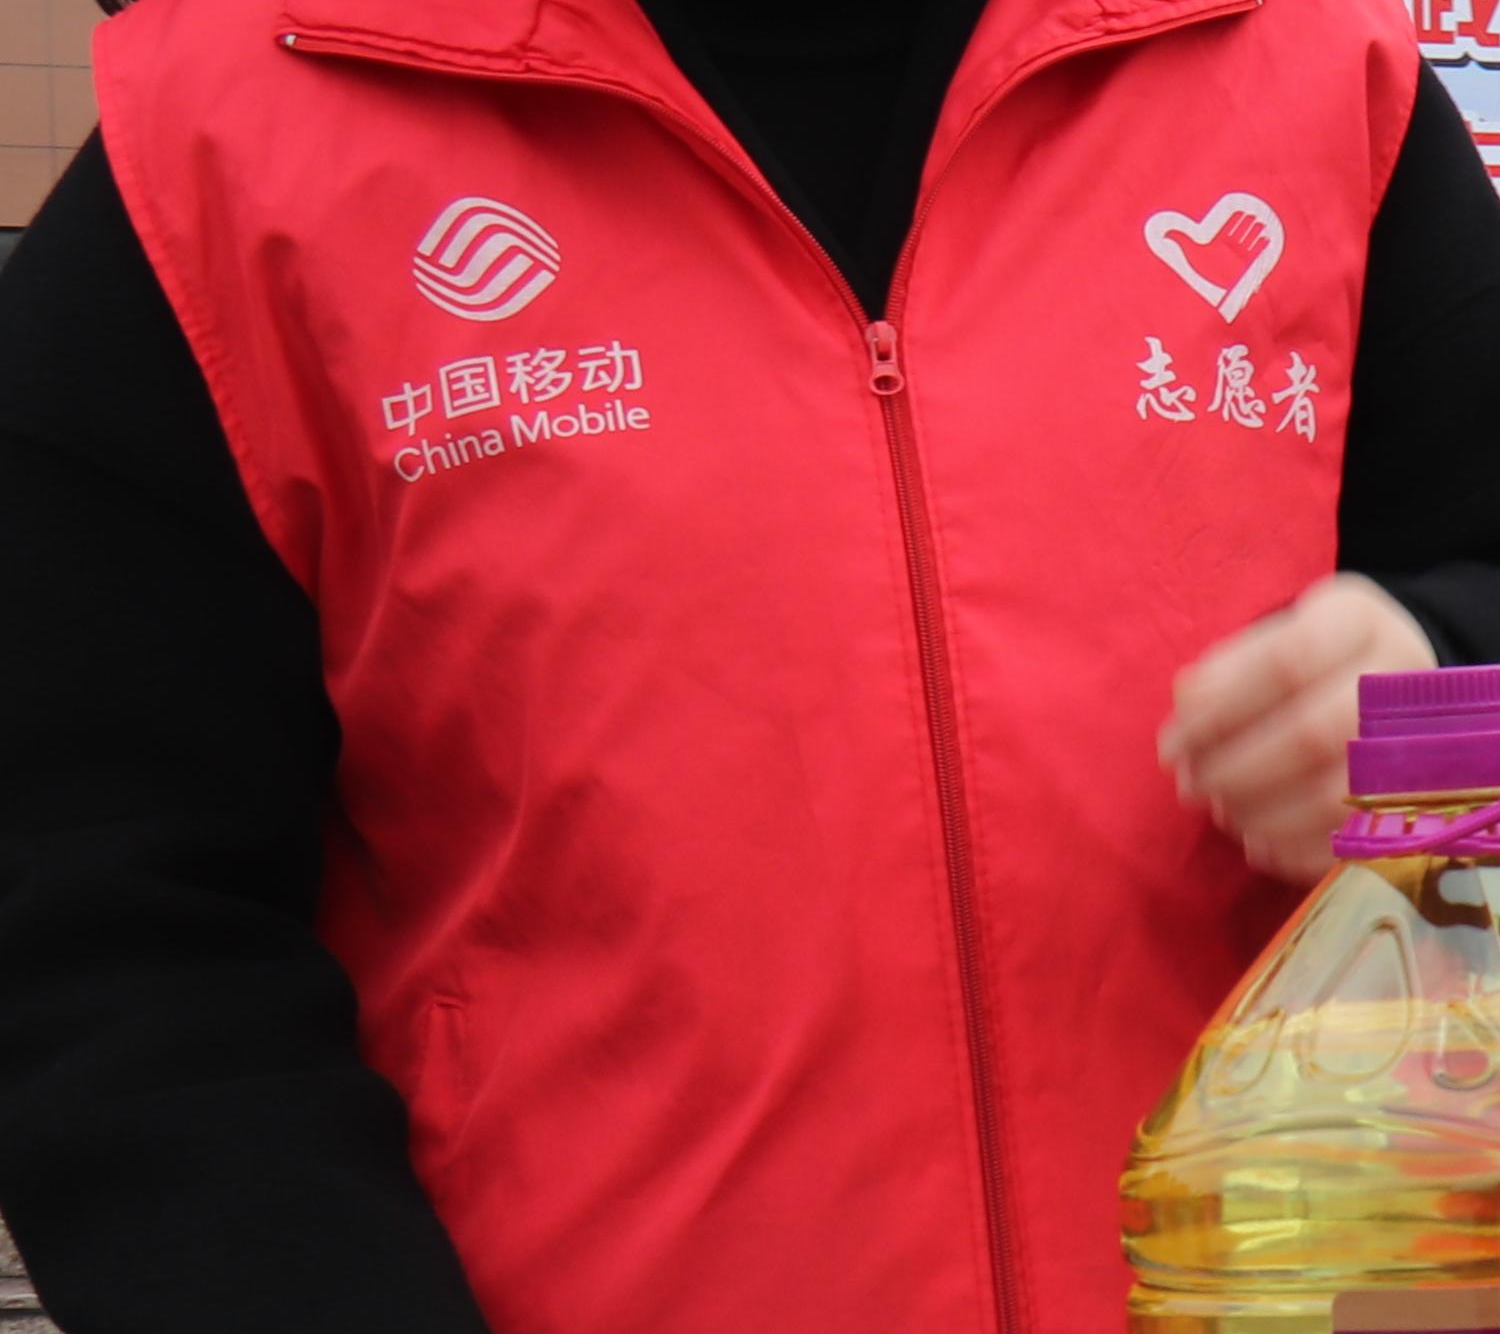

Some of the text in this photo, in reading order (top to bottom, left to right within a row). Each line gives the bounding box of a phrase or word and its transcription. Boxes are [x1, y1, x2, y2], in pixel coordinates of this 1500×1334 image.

[381, 340, 645, 438] 中国移动
[1136, 335, 1320, 444] 志愿者
[394, 398, 651, 484] China Mobile
